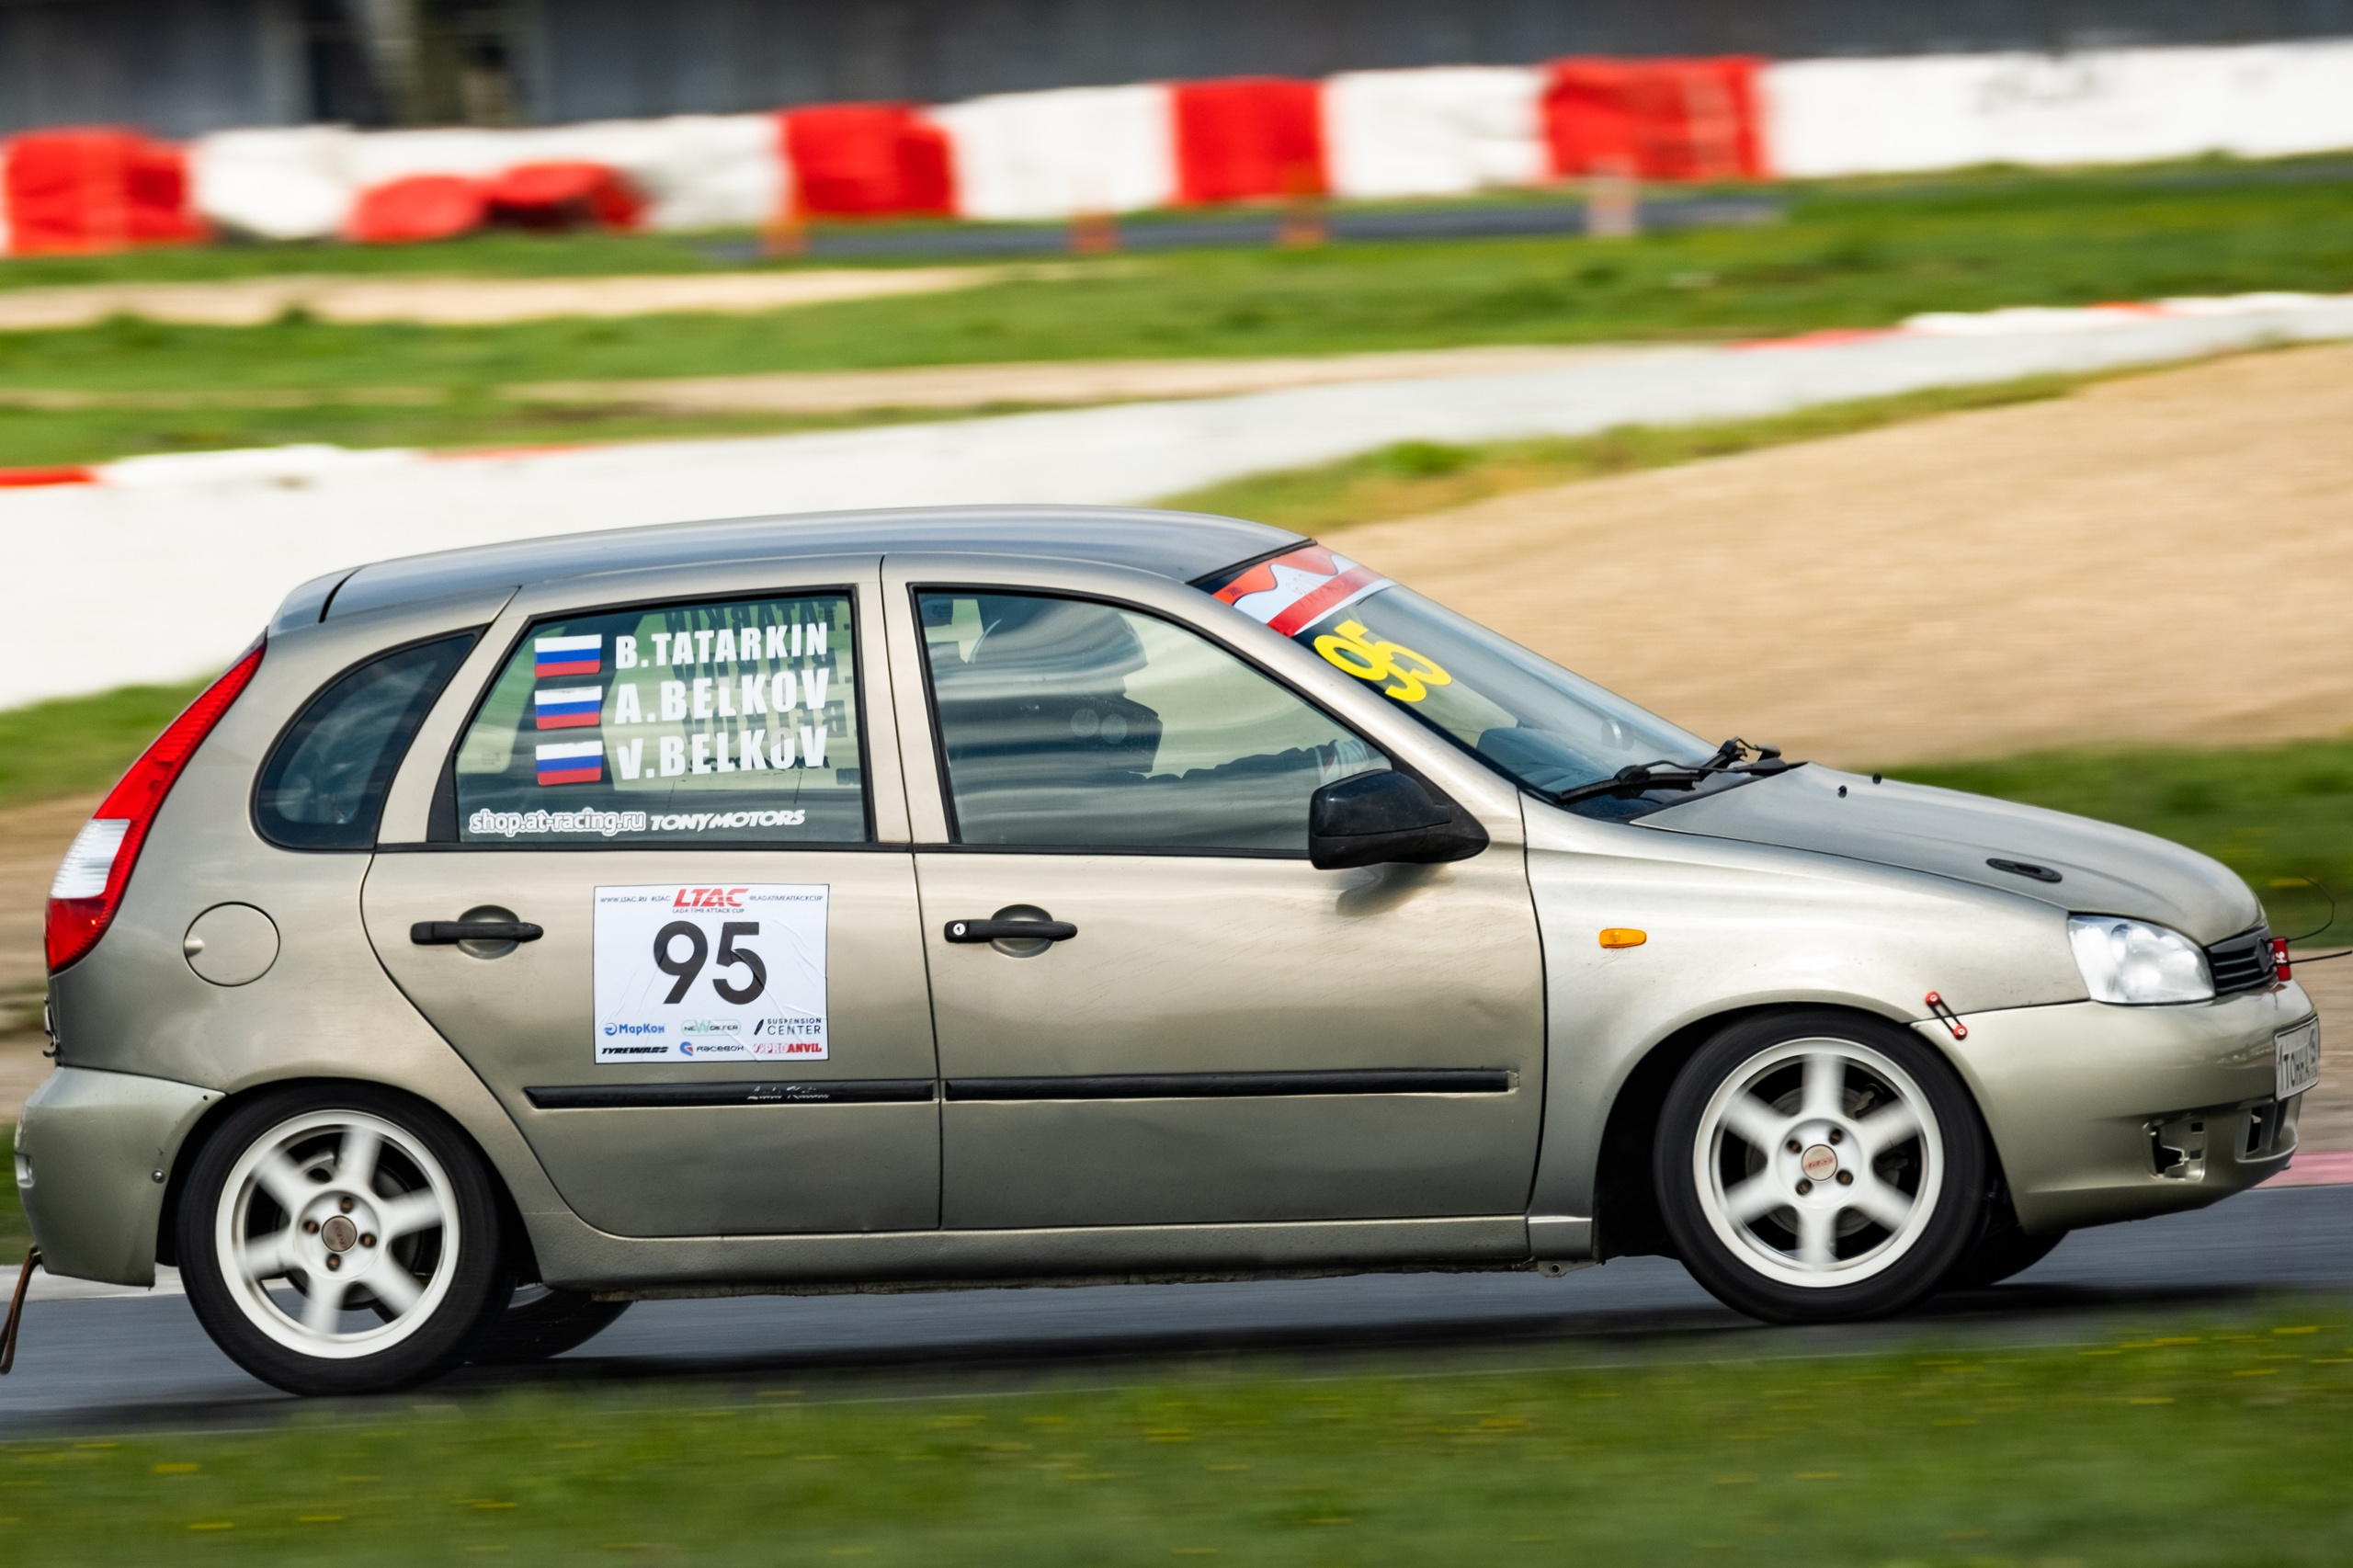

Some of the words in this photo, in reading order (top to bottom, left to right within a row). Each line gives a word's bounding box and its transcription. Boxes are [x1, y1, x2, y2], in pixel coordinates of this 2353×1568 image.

[616, 622, 827, 670] B.TATARKIN
[1313, 619, 1452, 702] 95
[614, 667, 831, 725] A.BELKOV
[616, 724, 828, 780] V.BELKOV
[469, 807, 646, 837] shop.at-racing.ru
[651, 809, 806, 833] TONYMOTORS
[673, 888, 749, 908] LTAC
[654, 920, 767, 1006] 95
[767, 1025, 822, 1036] CENTER
